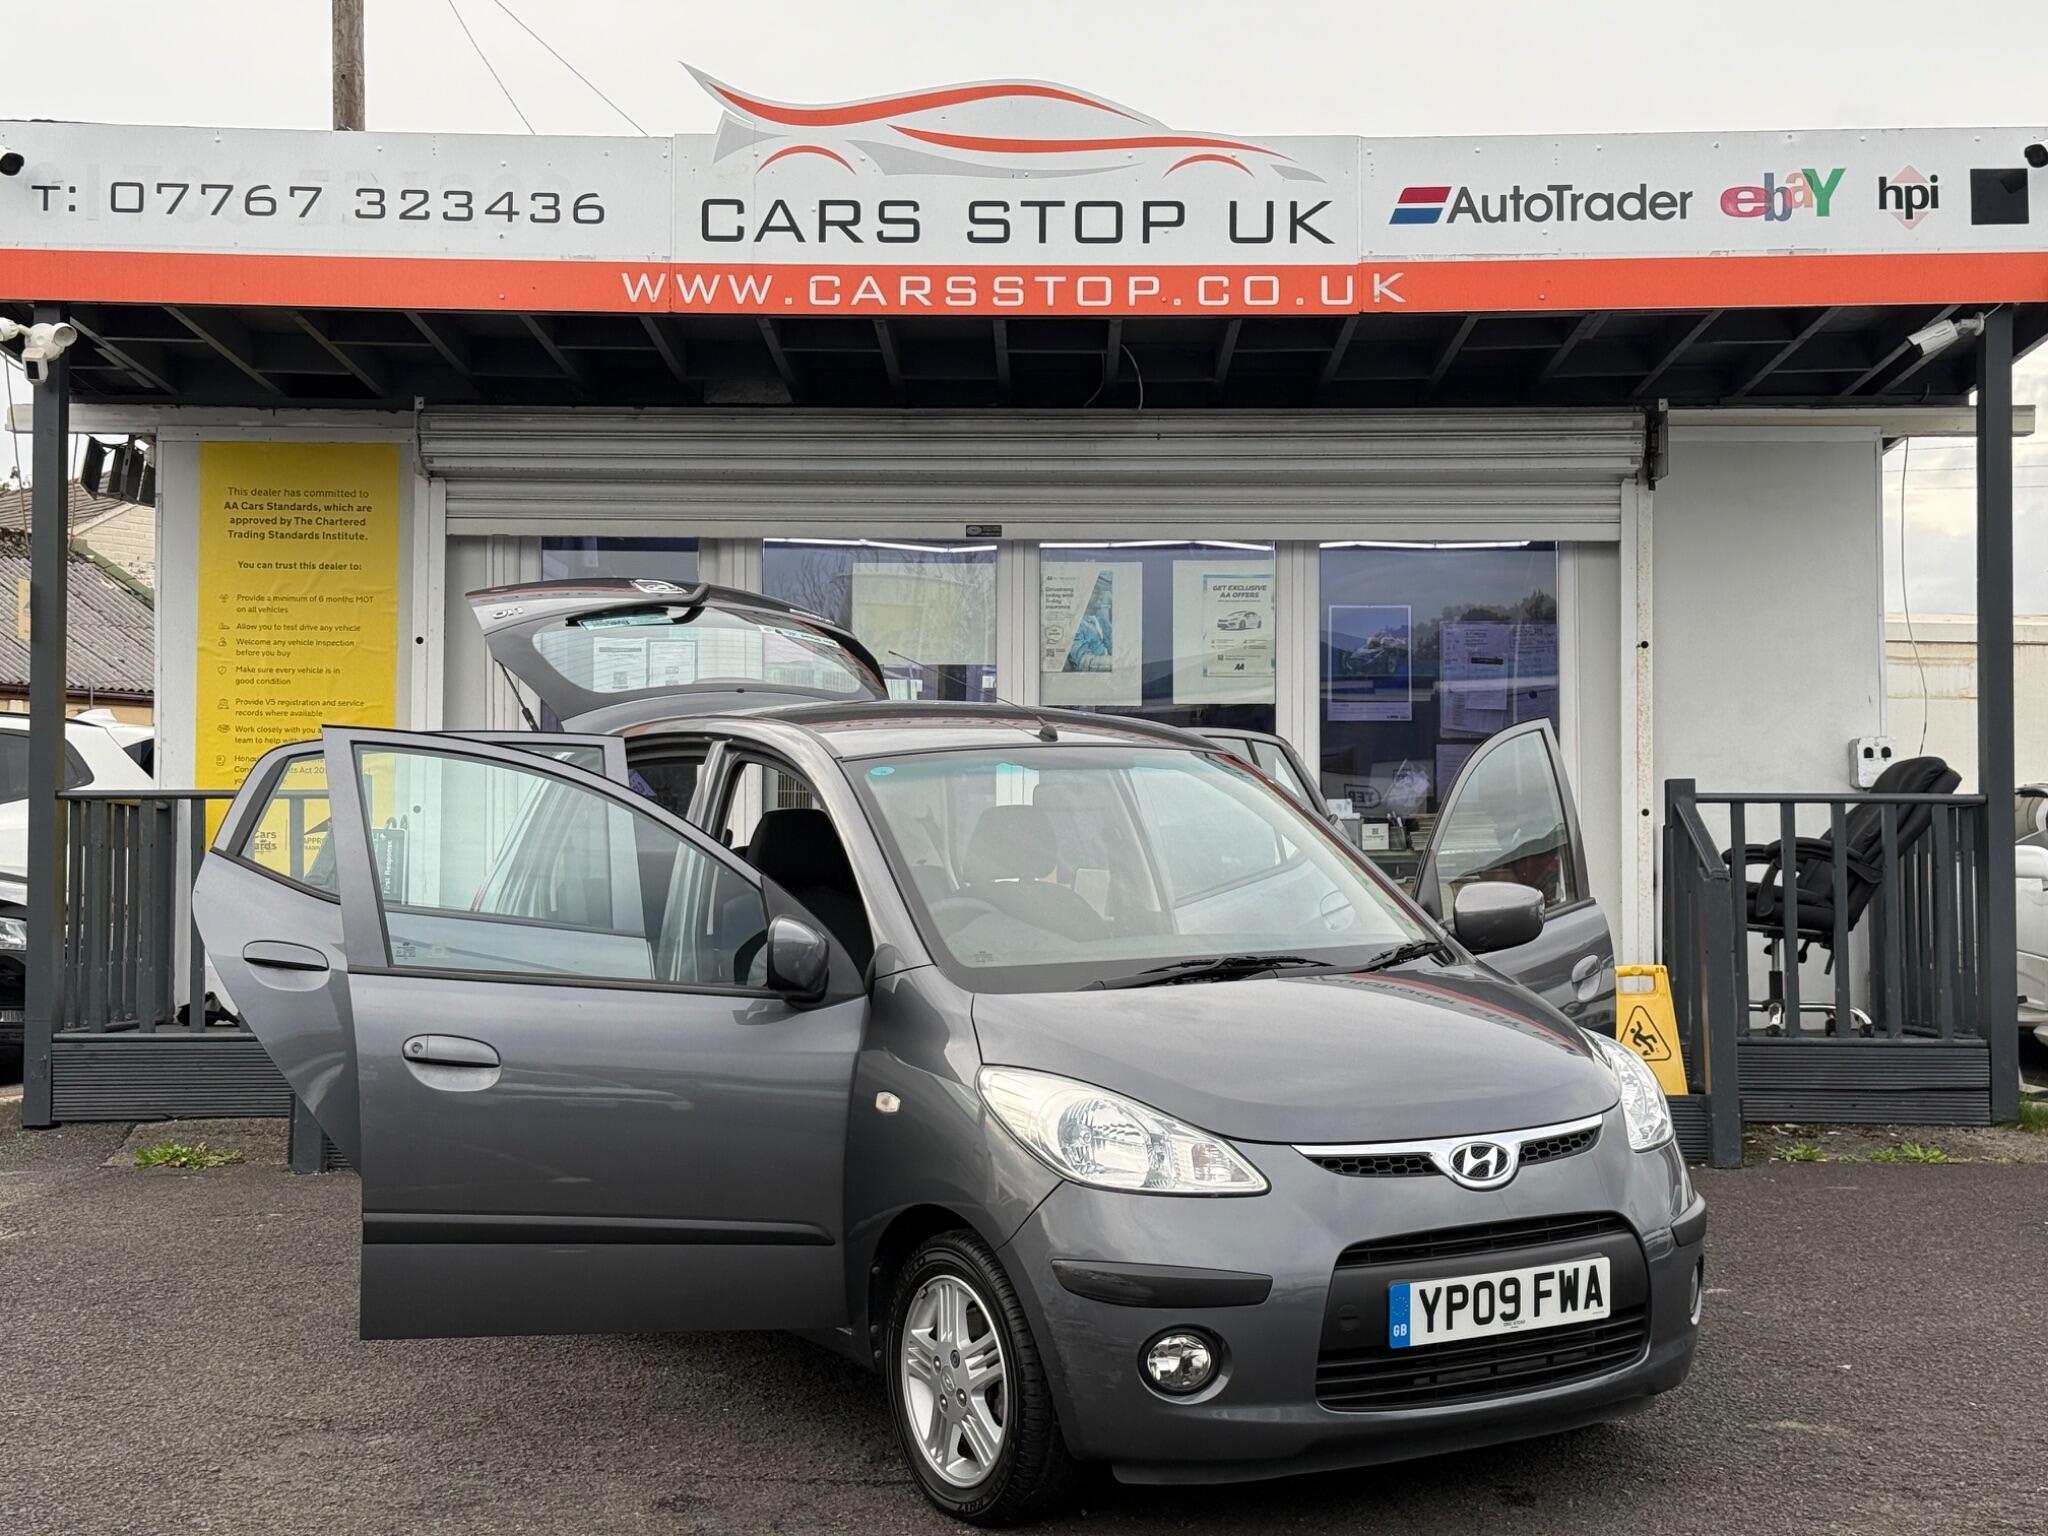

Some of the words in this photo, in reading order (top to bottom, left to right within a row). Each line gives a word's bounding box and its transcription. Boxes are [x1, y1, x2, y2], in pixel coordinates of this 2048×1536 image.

[1878, 175, 1938, 219] hpi
[32, 185, 75, 212] T:
[110, 182, 323, 218] 07767
[355, 187, 604, 224] 323436
[1446, 184, 1692, 223] AutoTrader
[701, 199, 919, 243] CARS
[967, 199, 1185, 243] STOP
[1229, 201, 1335, 245] UK
[622, 271, 1406, 308] WWW.CARSSTOP.CO.UK
[228, 487, 248, 496] This
[251, 488, 281, 497] dealer
[284, 489, 300, 497] has
[304, 489, 356, 498] committed
[359, 489, 369, 498] to
[224, 502, 238, 510] AA
[241, 502, 264, 510] Cars
[267, 502, 321, 512] Standards,
[324, 503, 353, 512] which
[230, 516, 277, 525] approved
[280, 517, 291, 526] by
[294, 517, 312, 525] The
[315, 517, 365, 526] Chartered
[228, 530, 265, 540] Trading
[269, 531, 319, 540] Standards
[322, 532, 368, 540] Institute.
[238, 561, 254, 569] You
[319, 562, 347, 570] dealer
[237, 594, 265, 602] Provide
[273, 595, 307, 603] minimum
[309, 595, 317, 603] of
[335, 624, 360, 632] vehicle
[278, 699, 320, 707] registration
[257, 726, 282, 734] closely
[265, 737, 281, 745] help
[1419, 1277, 1521, 1333] YP09
[1534, 1265, 1603, 1317] FWA
[1393, 1323, 1407, 1337] GB
